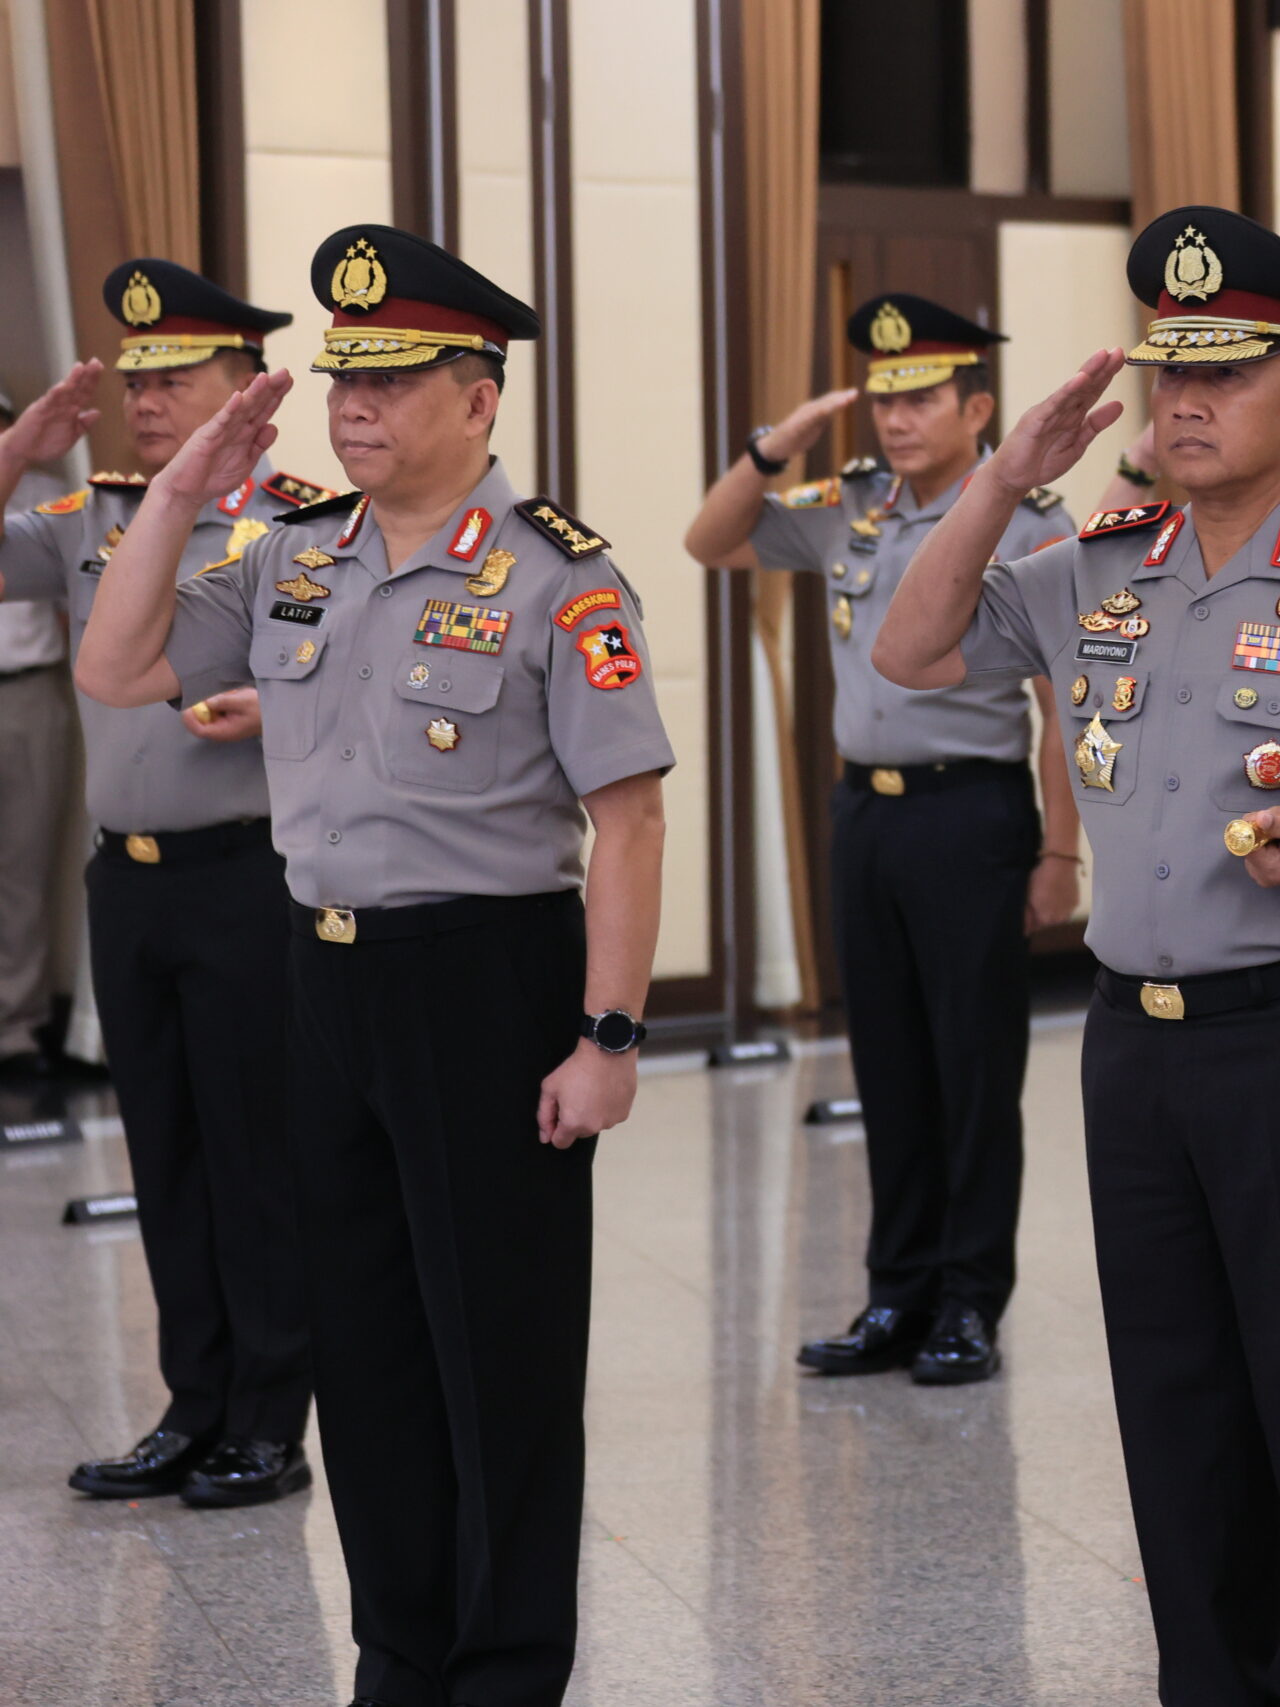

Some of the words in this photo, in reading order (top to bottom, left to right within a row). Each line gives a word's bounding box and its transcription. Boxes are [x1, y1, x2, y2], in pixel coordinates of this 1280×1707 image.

[280, 606, 313, 620] LATIF
[560, 593, 617, 625] BARESKRIM
[1082, 644, 1128, 657] MARDIYONO
[592, 662, 615, 682] MABES
[614, 659, 637, 670] POLRI
